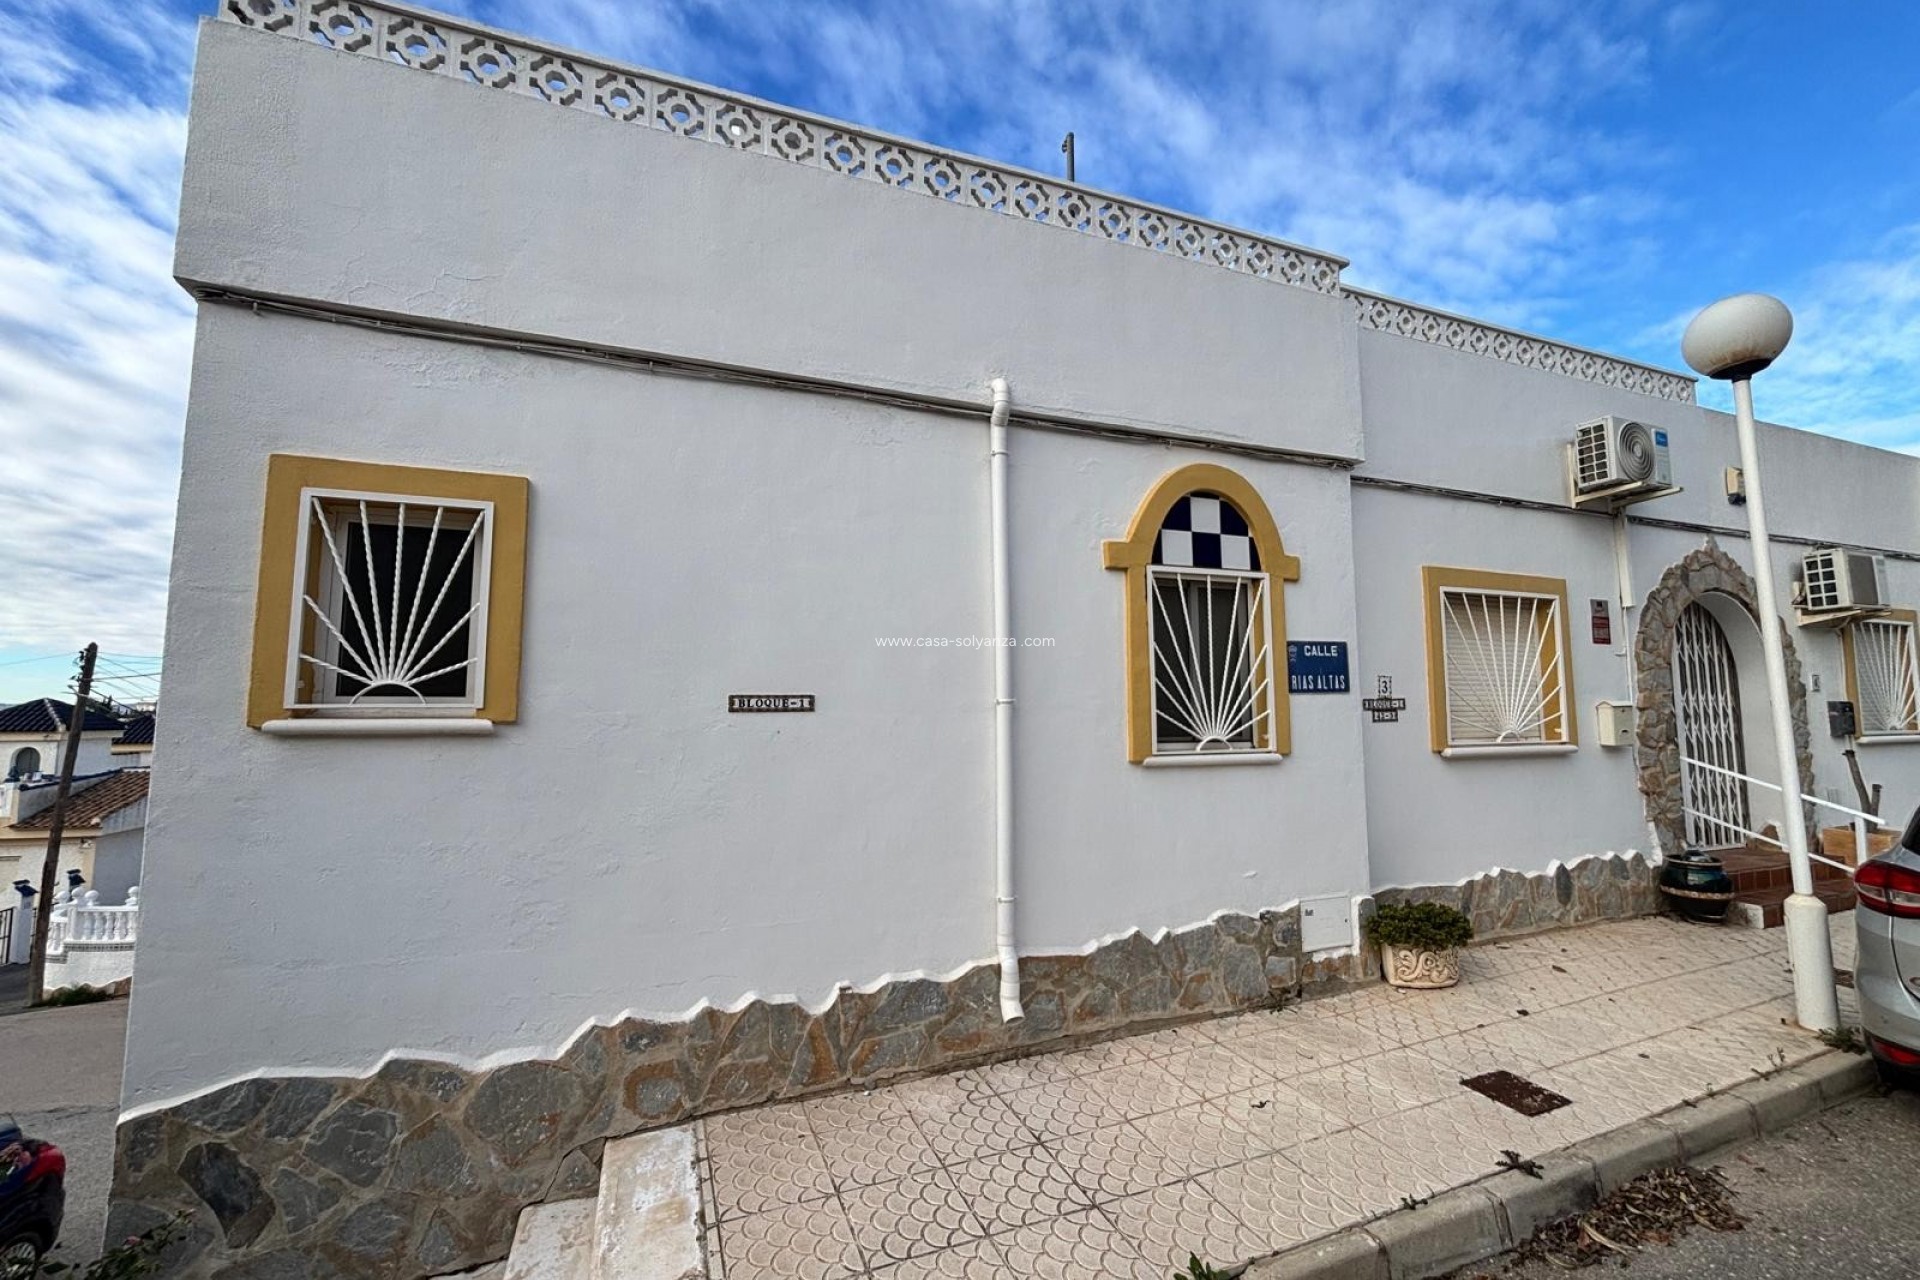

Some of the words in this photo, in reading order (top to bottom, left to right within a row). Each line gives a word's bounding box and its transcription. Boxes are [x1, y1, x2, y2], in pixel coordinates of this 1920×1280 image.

[1303, 645, 1338, 657] CALLE
[1291, 674, 1314, 690] RIAS
[1317, 674, 1345, 690] ALTAS
[1381, 680, 1388, 694] 3
[738, 698, 805, 708] BLOQUE-1
